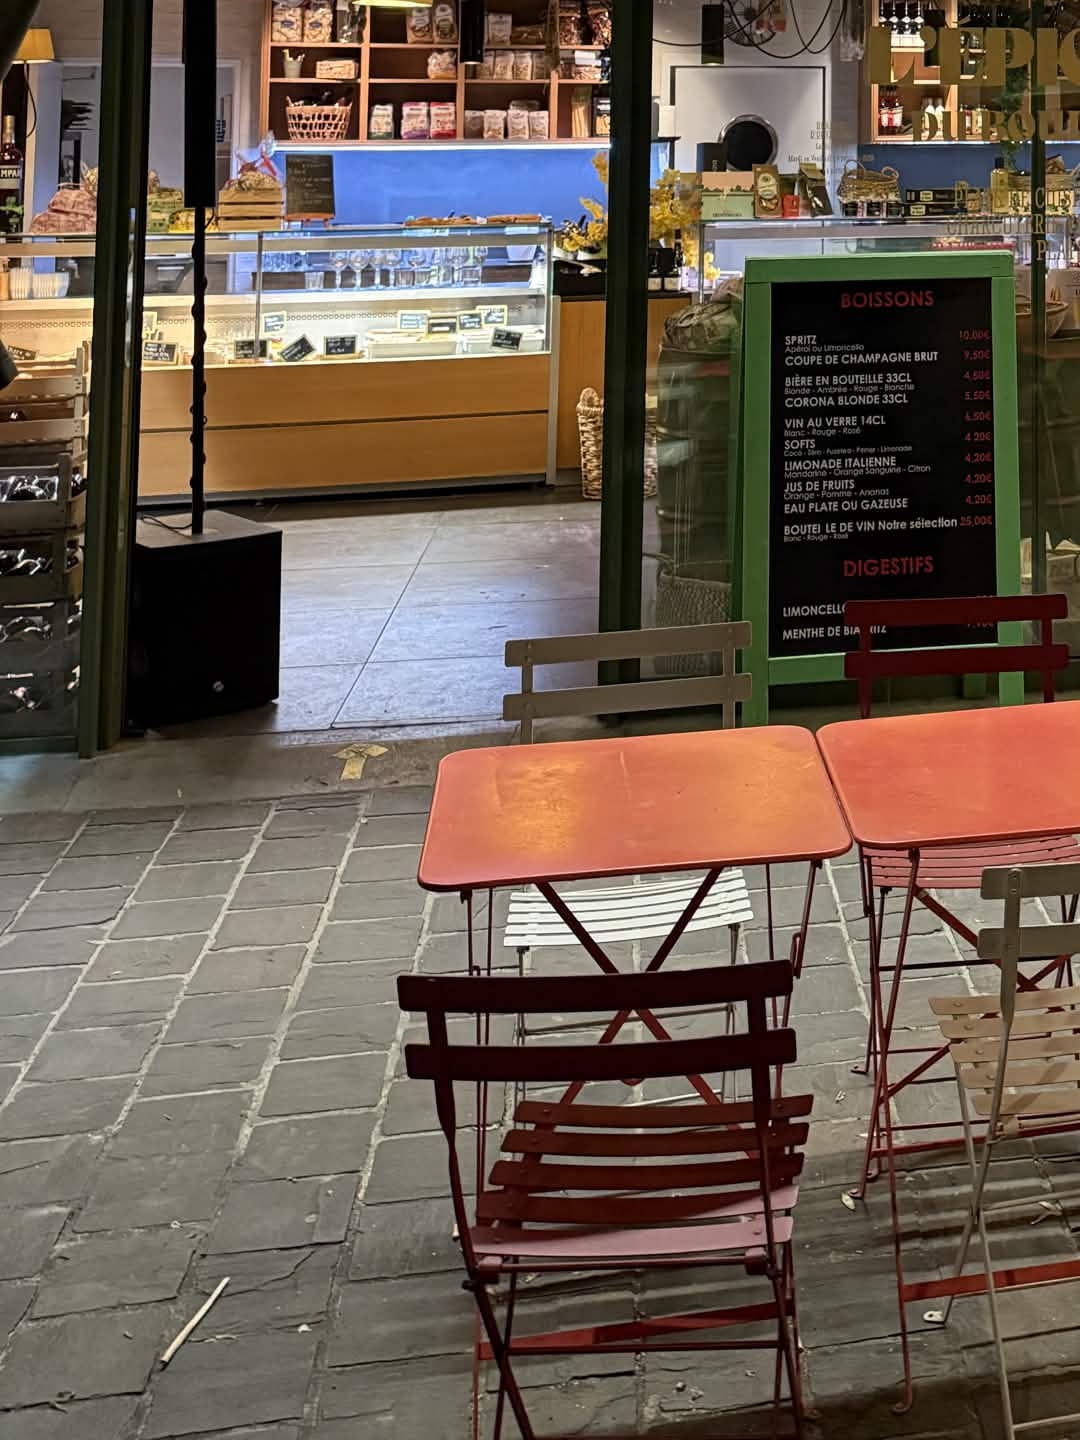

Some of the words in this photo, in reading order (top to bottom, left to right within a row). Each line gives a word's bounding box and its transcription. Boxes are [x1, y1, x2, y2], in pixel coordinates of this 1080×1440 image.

[840, 290, 936, 309] BOISSONS
[785, 335, 817, 346] SPRITZ
[785, 354, 822, 366] COUPE
[825, 354, 839, 365] DE
[841, 352, 911, 365] CHAMPAGNE
[914, 351, 938, 362] BRUT
[785, 373, 813, 387] BIÈRE
[816, 375, 829, 386] EN
[832, 373, 883, 386] BOUTEILLE
[886, 372, 912, 383] 33CL
[785, 396, 835, 408] CORONA
[838, 395, 880, 406] BLONDE
[882, 393, 908, 404] 33CL
[784, 418, 804, 429] VIN
[806, 417, 824, 428] AU
[826, 416, 857, 427] VERRE
[860, 415, 886, 426] 14CL
[784, 439, 815, 450] SOFTS
[784, 458, 841, 471] LIMONADE
[844, 456, 897, 469] ITALIENNE
[784, 482, 803, 493] JUS
[806, 481, 820, 491] DE
[822, 479, 855, 491] FRUITS
[784, 503, 805, 515] EAU
[808, 501, 839, 513] PLATE
[841, 500, 858, 511] OU
[860, 498, 909, 510] GAZEUSE
[784, 523, 837, 536] BOUTEILE
[839, 522, 854, 533] DE
[856, 521, 875, 531] VIN
[877, 519, 907, 532] Notre
[909, 516, 958, 529] sélection
[842, 555, 935, 578] DIGESTIFS
[782, 626, 825, 641] MENTHE
[826, 625, 842, 638] DE
